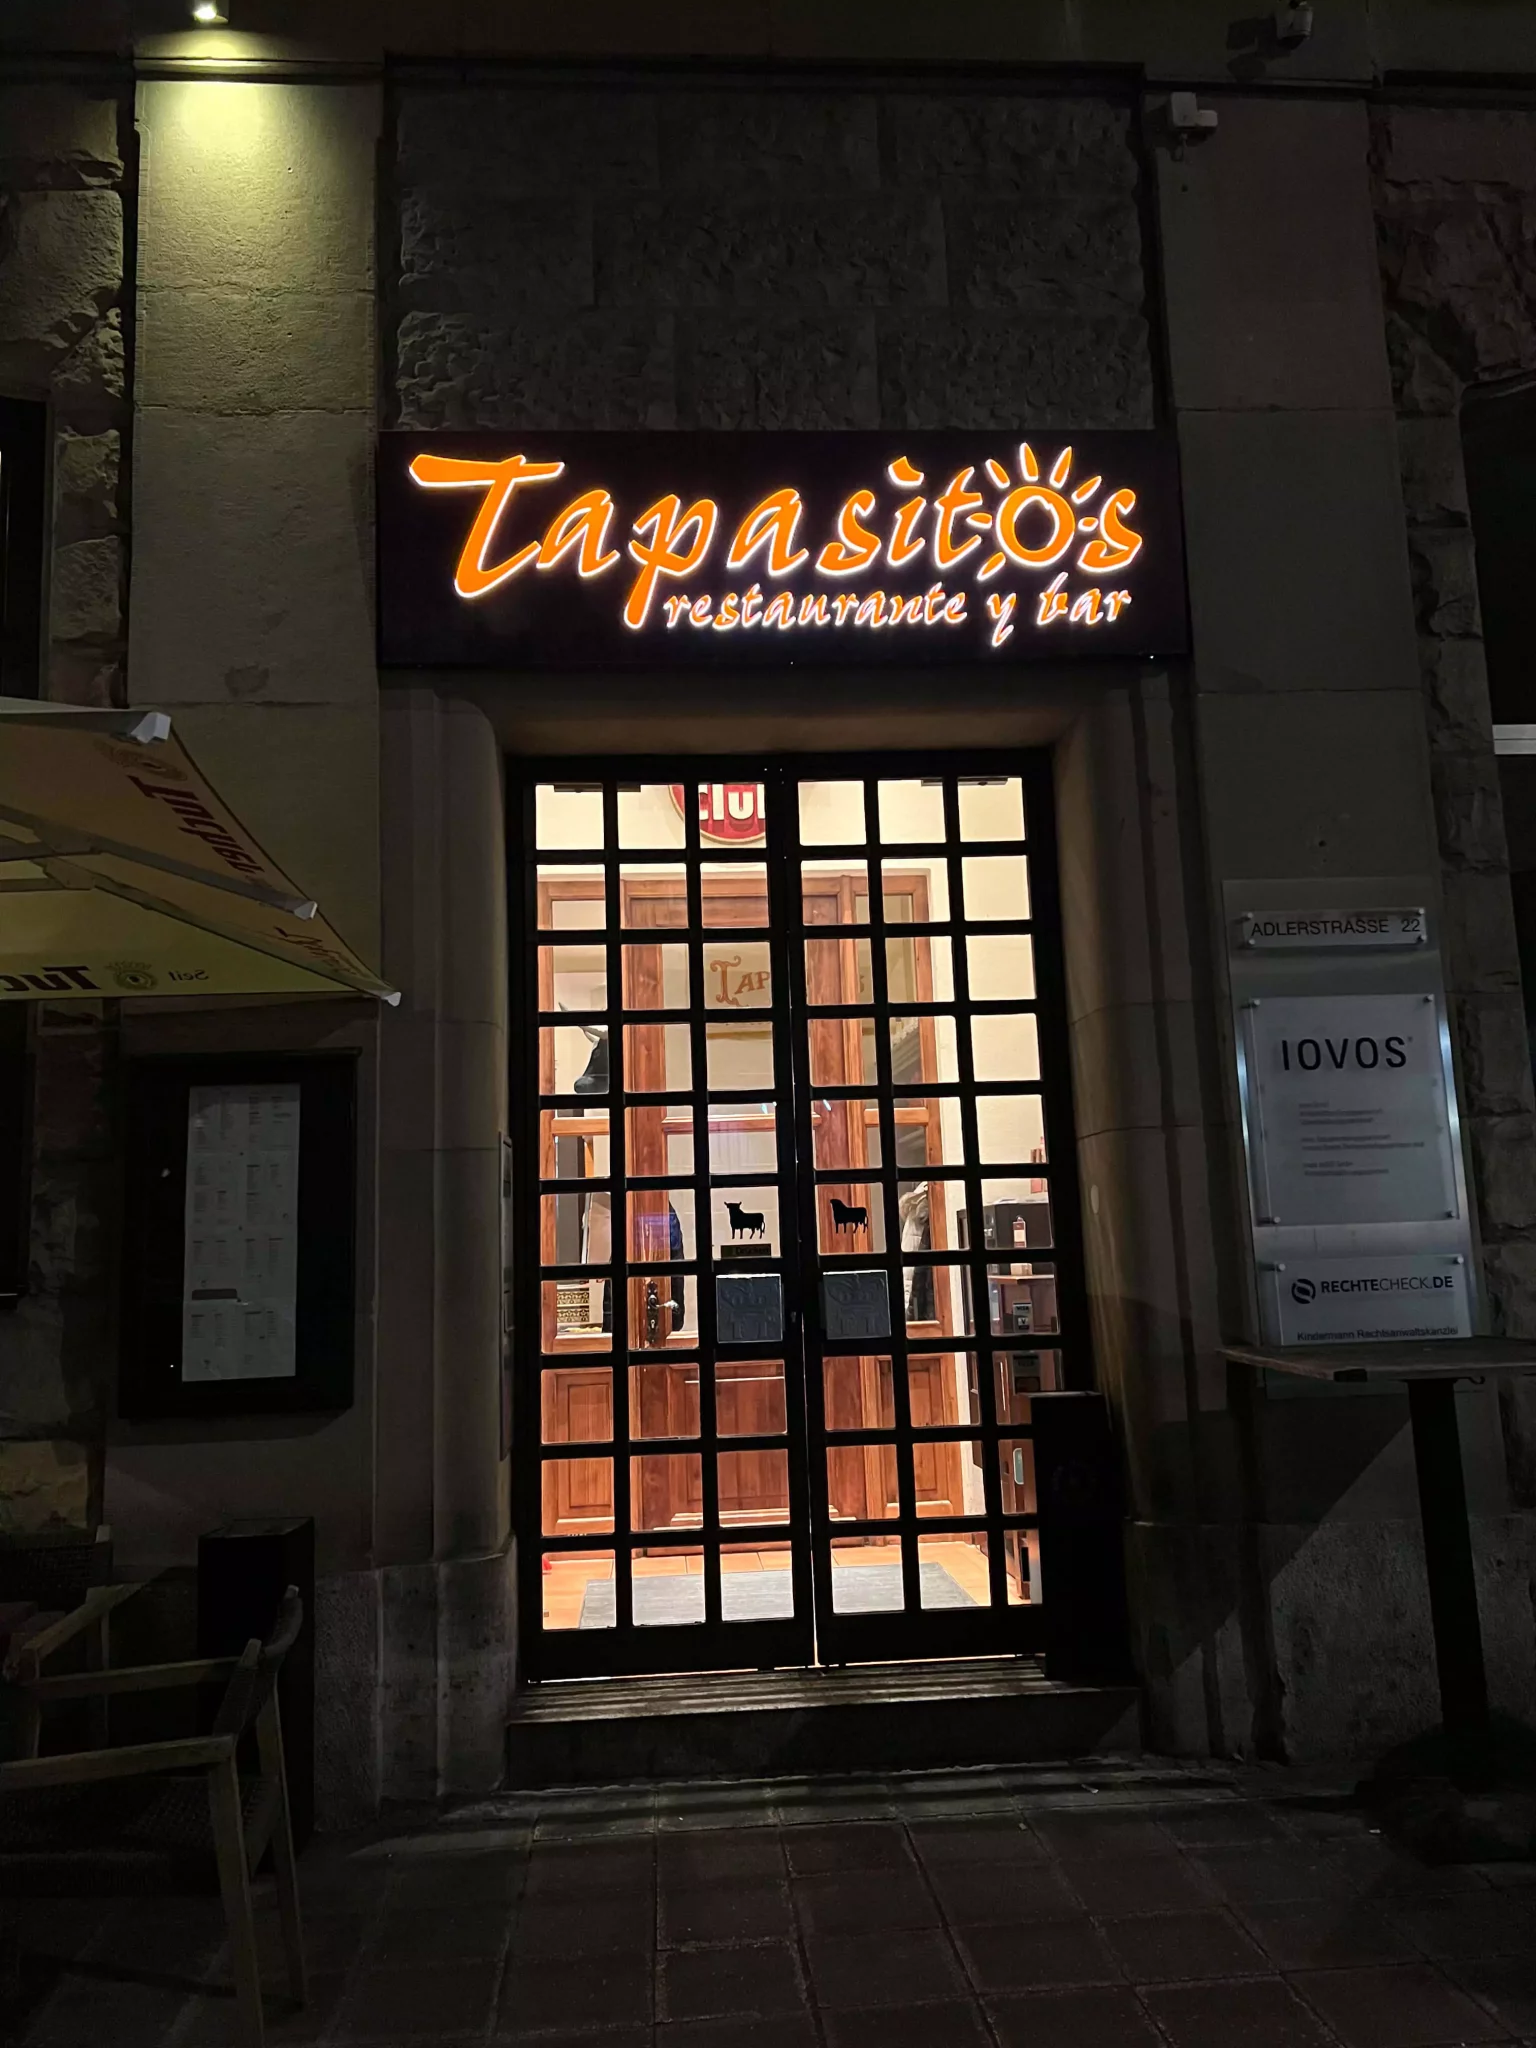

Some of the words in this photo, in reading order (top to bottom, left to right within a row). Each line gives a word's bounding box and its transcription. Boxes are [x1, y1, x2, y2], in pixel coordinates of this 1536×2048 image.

[408, 443, 1144, 631] Tapasitos
[664, 582, 968, 631] restaurante
[988, 592, 1015, 648] y
[1036, 572, 1133, 627] bar
[1251, 919, 1390, 937] ADLERSTRASSE
[1401, 917, 1421, 933] 22
[1281, 1037, 1407, 1071] IOVOS
[1321, 1275, 1454, 1294] RECHTECHECK.DE
